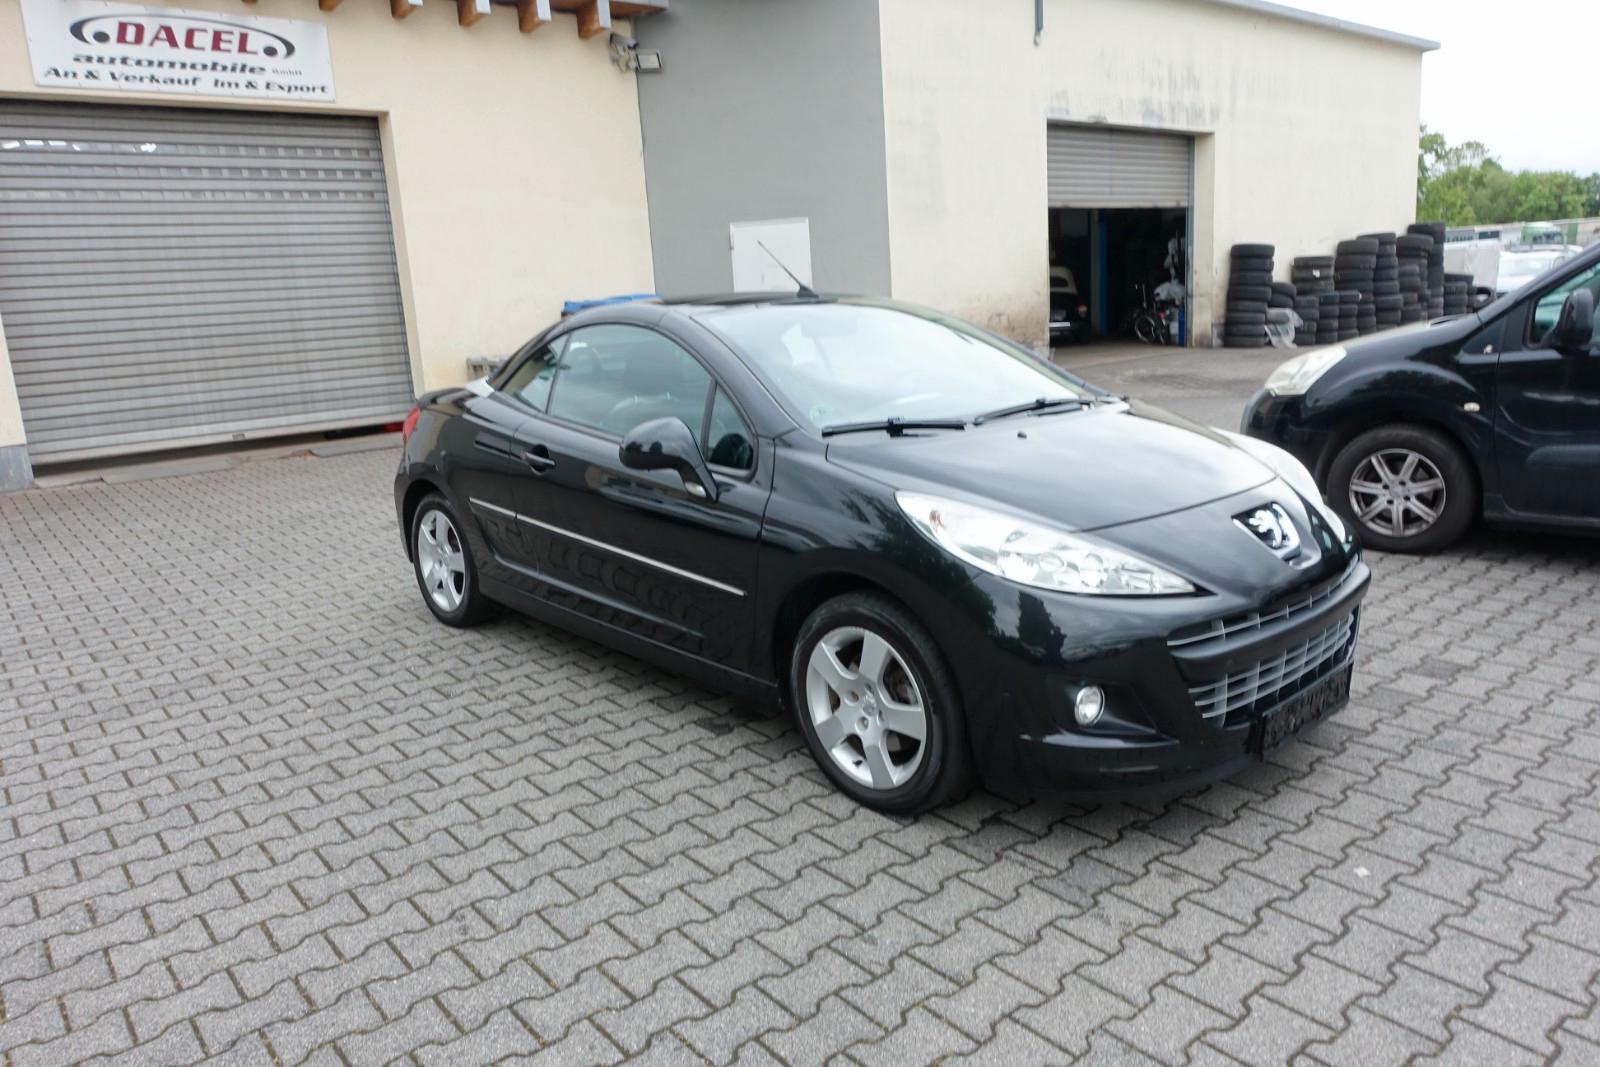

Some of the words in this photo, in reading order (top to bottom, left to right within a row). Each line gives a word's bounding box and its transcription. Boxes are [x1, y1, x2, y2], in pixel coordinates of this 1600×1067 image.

[116, 21, 259, 55] DACEL
[73, 53, 266, 75] automobile
[44, 67, 78, 79] An
[85, 69, 101, 81] &
[108, 71, 201, 86] Verkauf
[245, 80, 258, 90] &
[265, 81, 329, 94] Export
